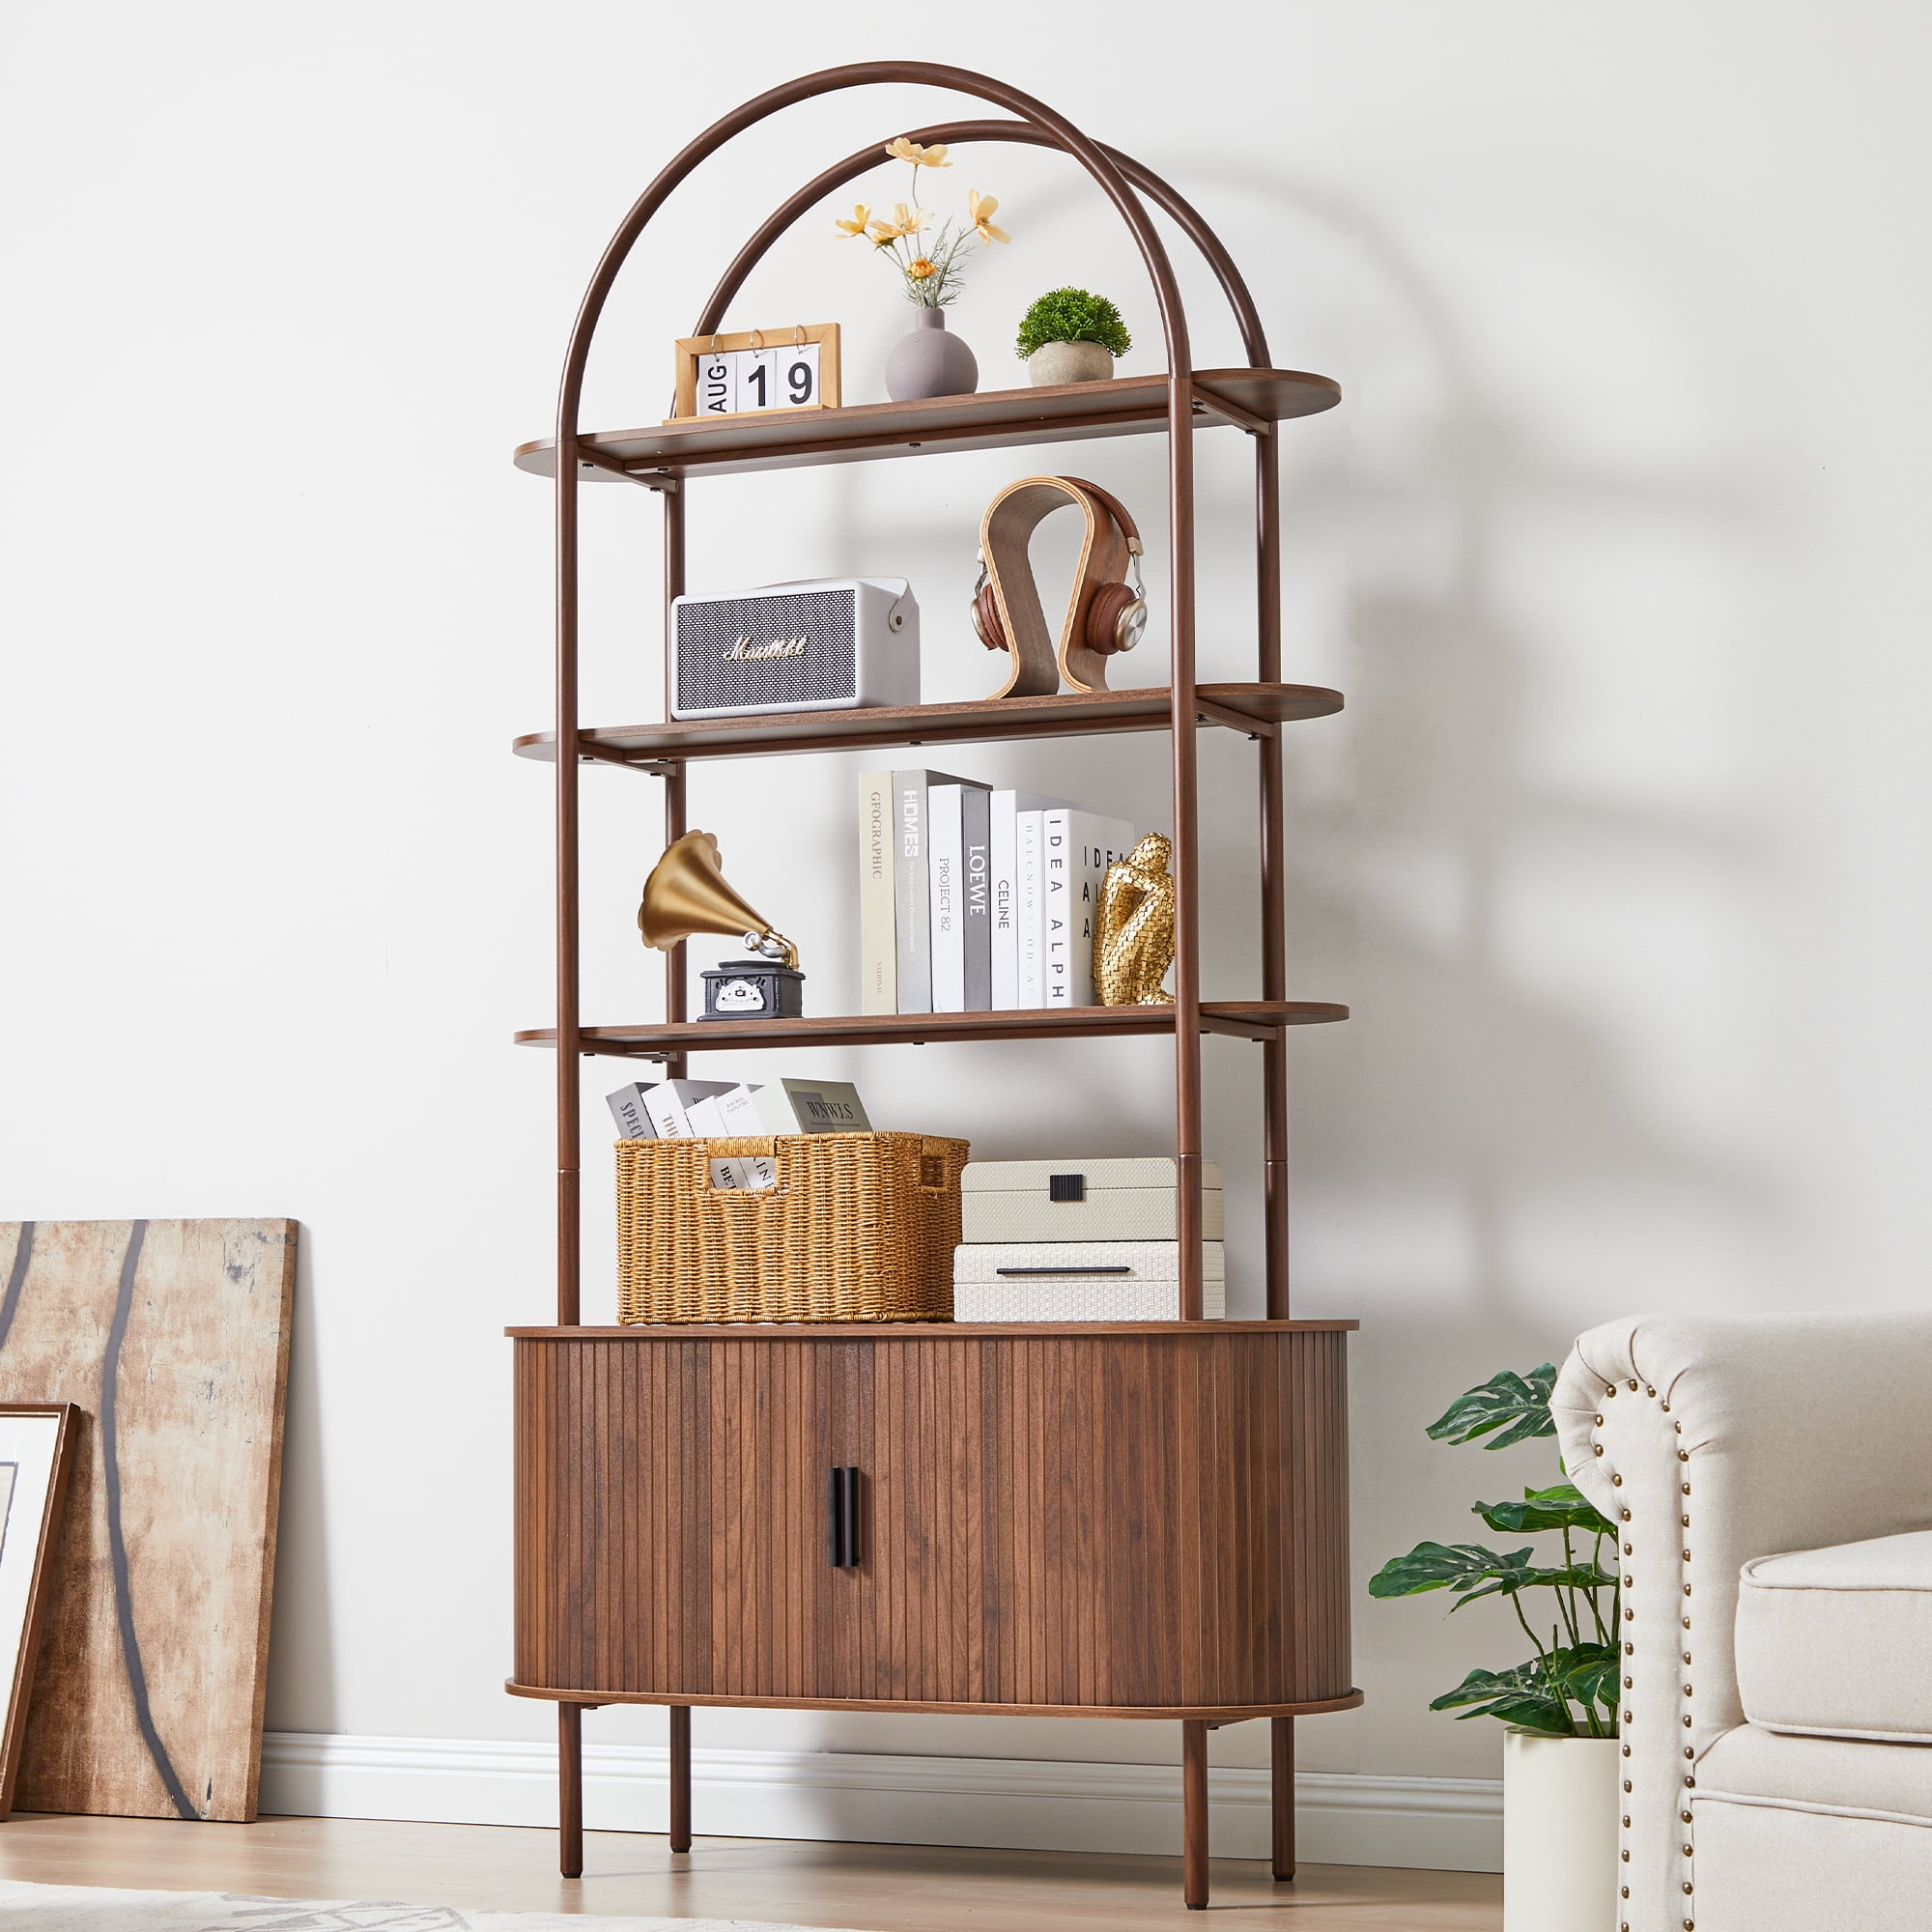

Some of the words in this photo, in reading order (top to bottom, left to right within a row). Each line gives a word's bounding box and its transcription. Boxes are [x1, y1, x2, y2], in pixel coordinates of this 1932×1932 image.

[707, 365, 727, 413] AUG
[903, 789, 920, 858] HOMES
[969, 844, 986, 917] LOEWE
[1049, 819, 1063, 893] IDEA
[939, 857, 951, 913] PROJECT
[998, 879, 1009, 929] CELINE
[940, 916, 951, 932] 82
[1051, 919, 1065, 998] ALPH
[619, 1101, 647, 1139] SPECI
